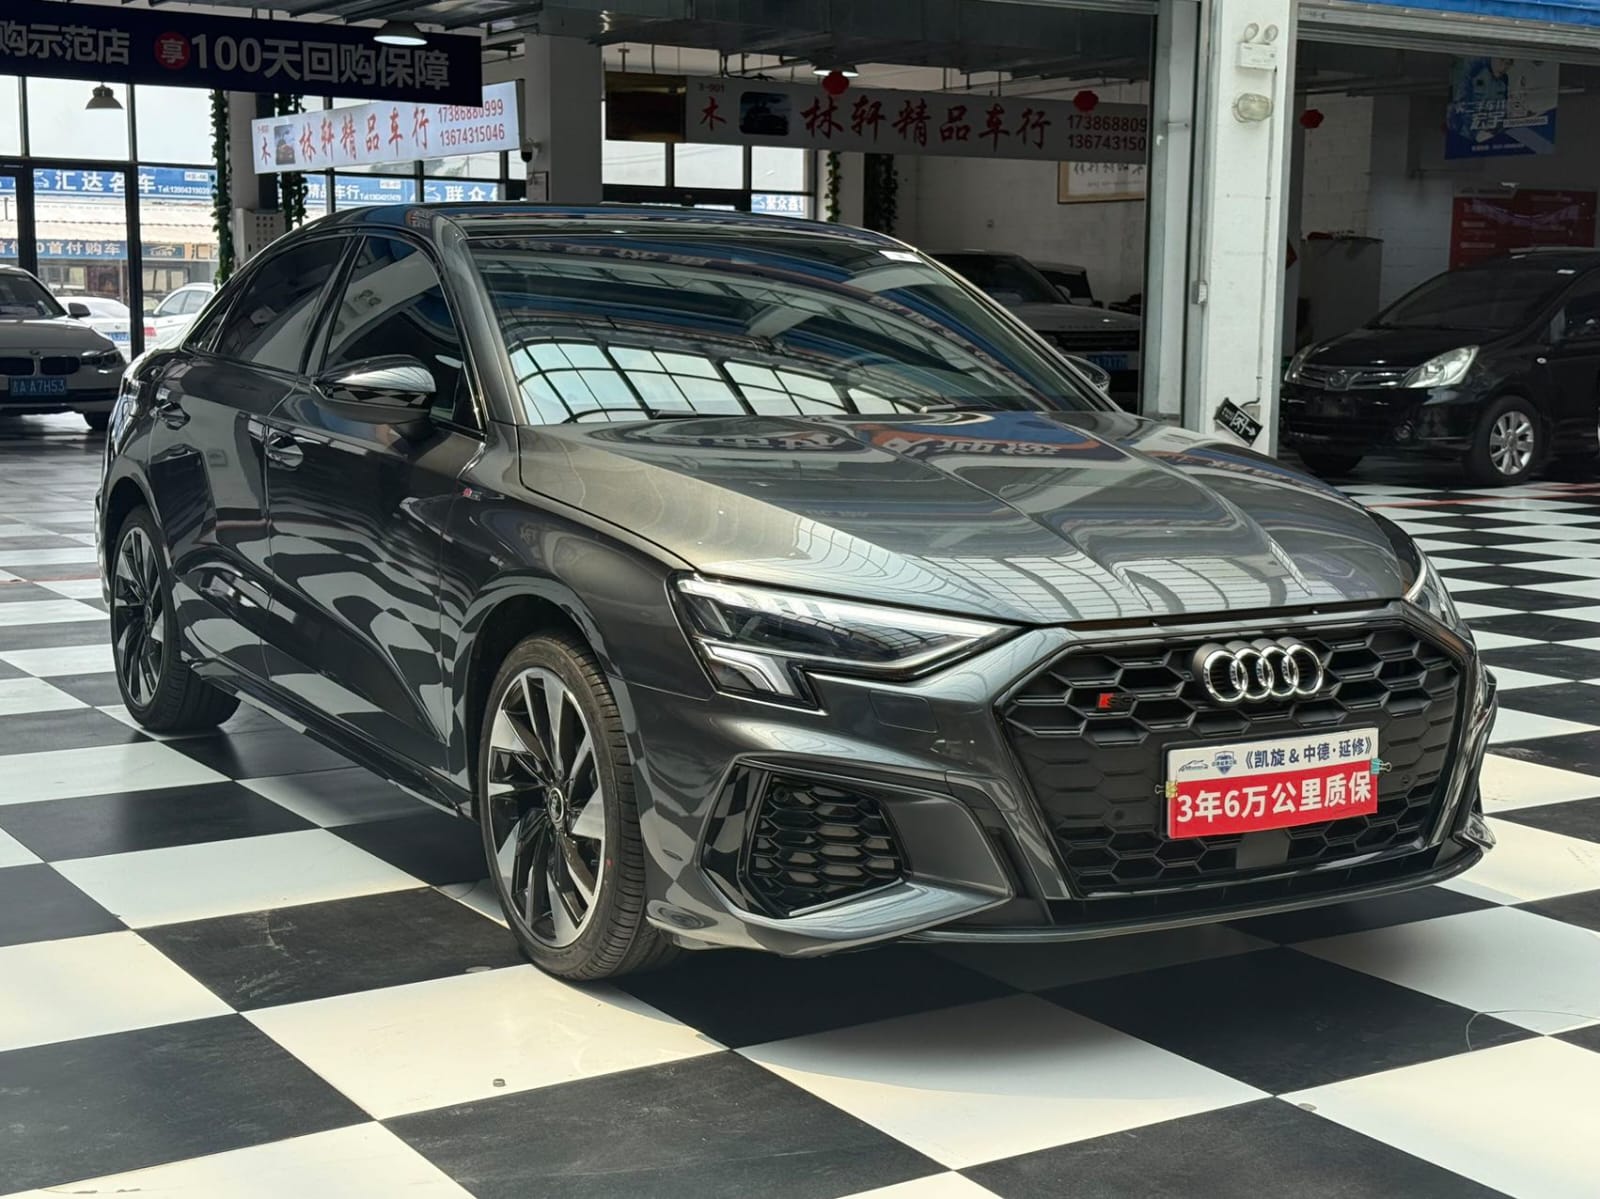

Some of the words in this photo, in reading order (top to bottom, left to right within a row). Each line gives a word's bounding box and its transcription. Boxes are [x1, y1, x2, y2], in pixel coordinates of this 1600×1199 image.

[0, 20, 130, 65] 购示范店
[161, 38, 184, 63] 享
[191, 34, 449, 90] 100天回购保障
[440, 124, 505, 147] 13674315046
[1177, 770, 1371, 823] 3年6万公里质保
